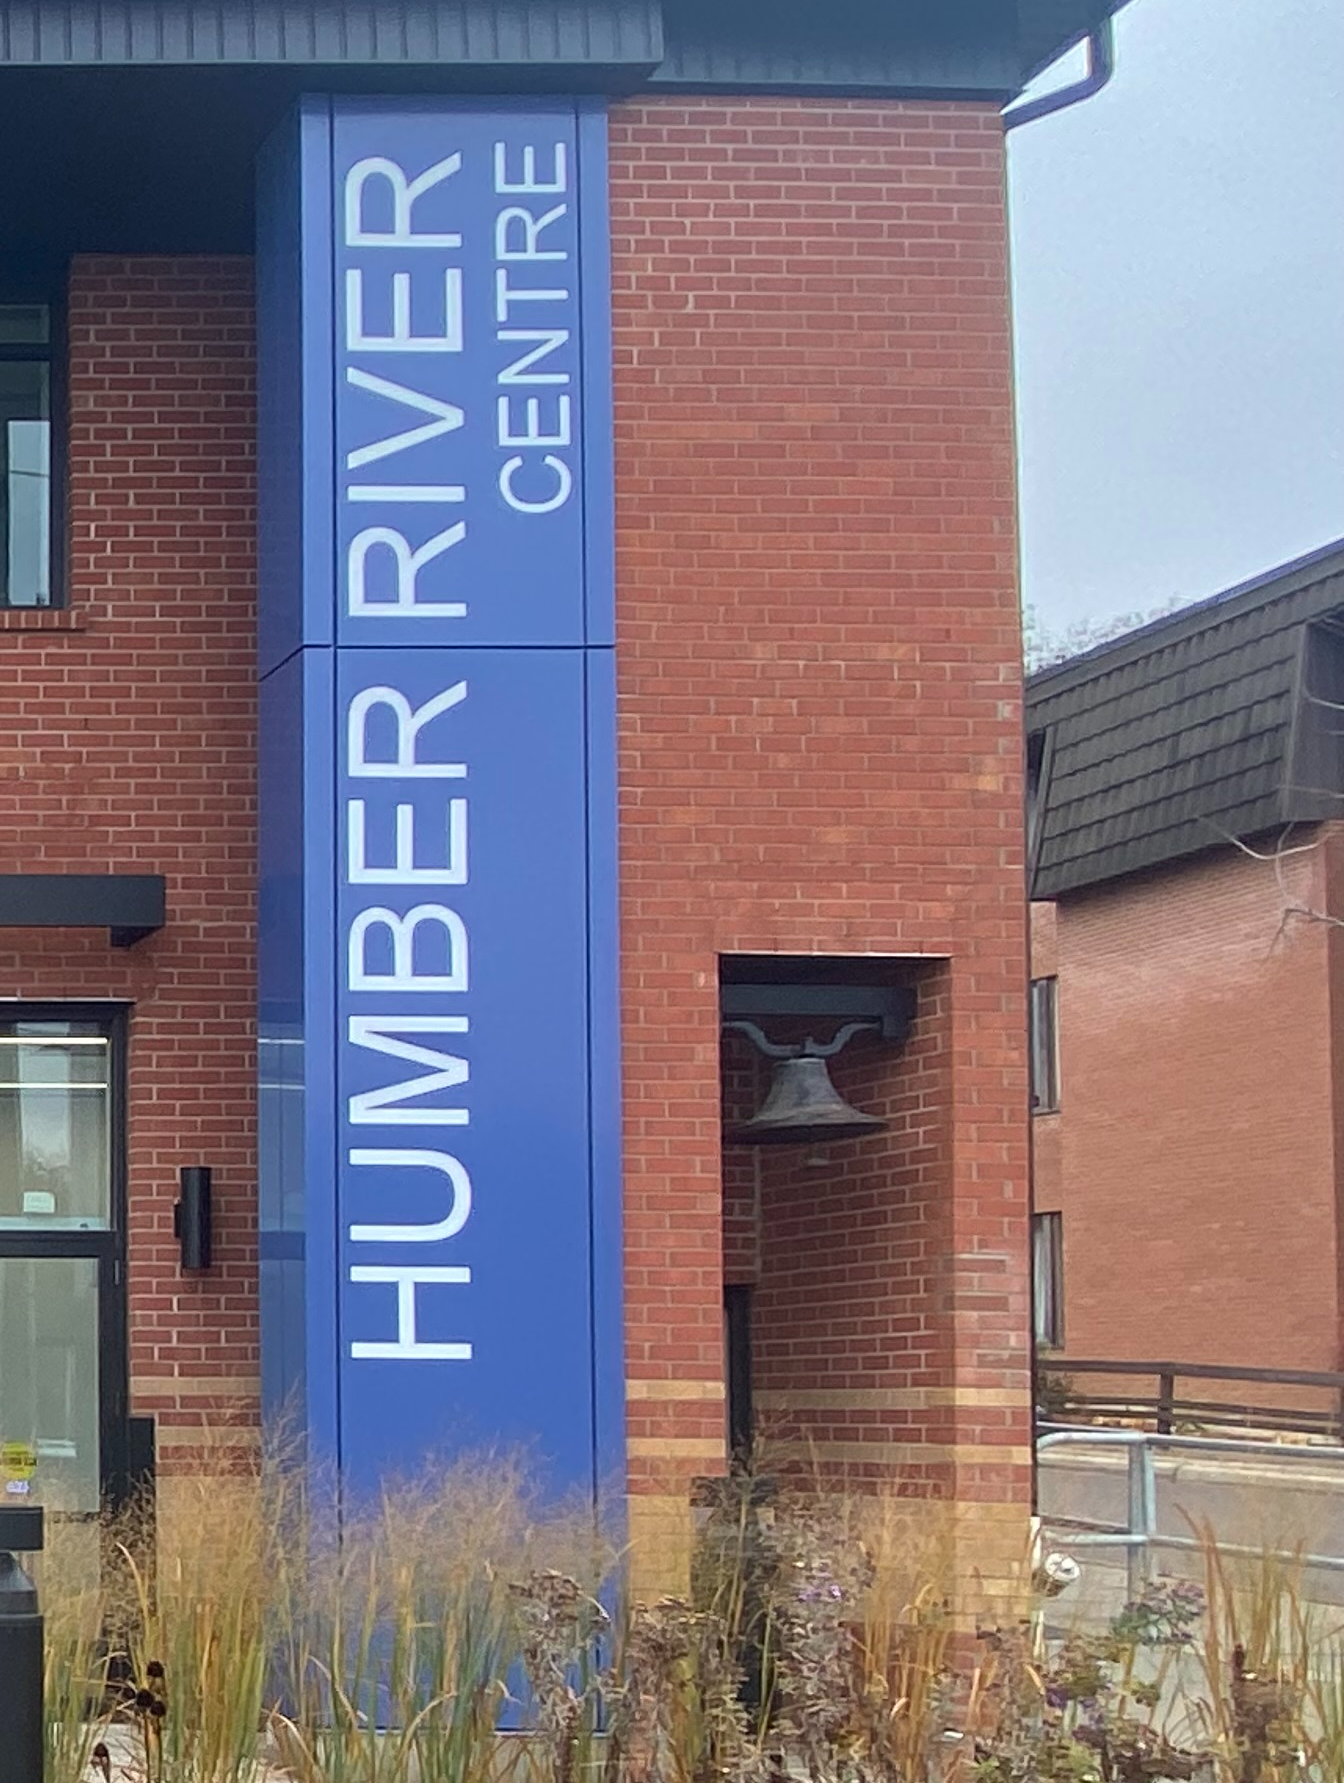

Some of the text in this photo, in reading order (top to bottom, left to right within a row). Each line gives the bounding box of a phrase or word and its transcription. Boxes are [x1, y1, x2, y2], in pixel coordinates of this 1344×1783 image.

[494, 140, 573, 514] CENTRE
[344, 150, 472, 1360] HUMBER RIVER
